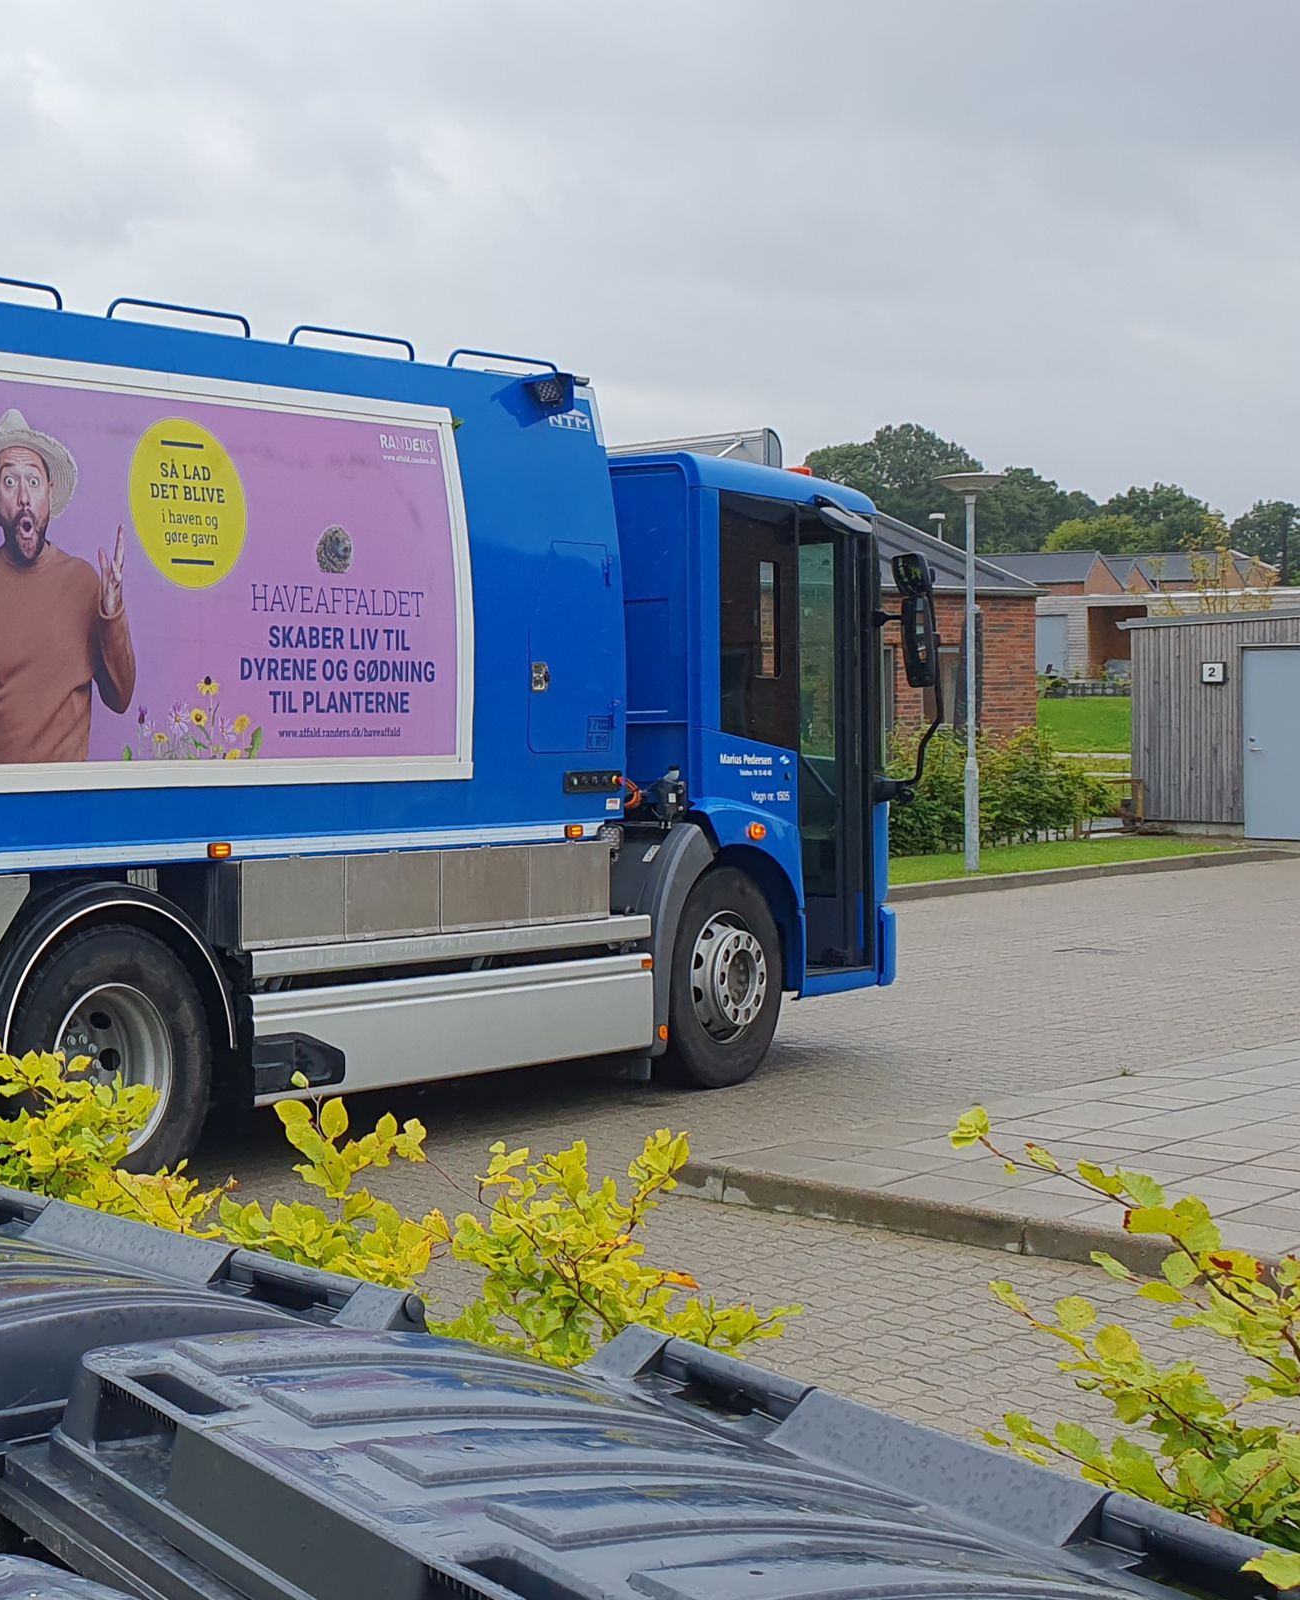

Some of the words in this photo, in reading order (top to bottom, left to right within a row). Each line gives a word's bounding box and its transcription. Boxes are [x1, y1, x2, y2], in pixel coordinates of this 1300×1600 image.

[548, 413, 591, 431] NTM
[379, 433, 434, 453] RANDERS
[160, 458, 180, 479] SÅ
[182, 464, 211, 481] LAD
[150, 483, 179, 500] DET
[183, 486, 226, 504] BLIVE
[161, 508, 167, 524] i
[168, 509, 203, 526] haven
[204, 515, 219, 530] og
[164, 531, 189, 546] gøre
[191, 533, 219, 548] gavn
[251, 583, 424, 618] HAVEAFFALDET
[268, 625, 345, 650] SKABER
[350, 628, 379, 651] LIV
[383, 629, 411, 651] TIL
[240, 657, 317, 682] DYRENE
[322, 659, 348, 682] OG
[353, 660, 436, 683] GØDNING
[1208, 666, 1216, 678] 2
[269, 690, 298, 714] TIL
[302, 691, 410, 714] PLANTERNE
[720, 753, 742, 765] Marius
[743, 754, 772, 765] Pedersen
[751, 791, 767, 804] Vogn
